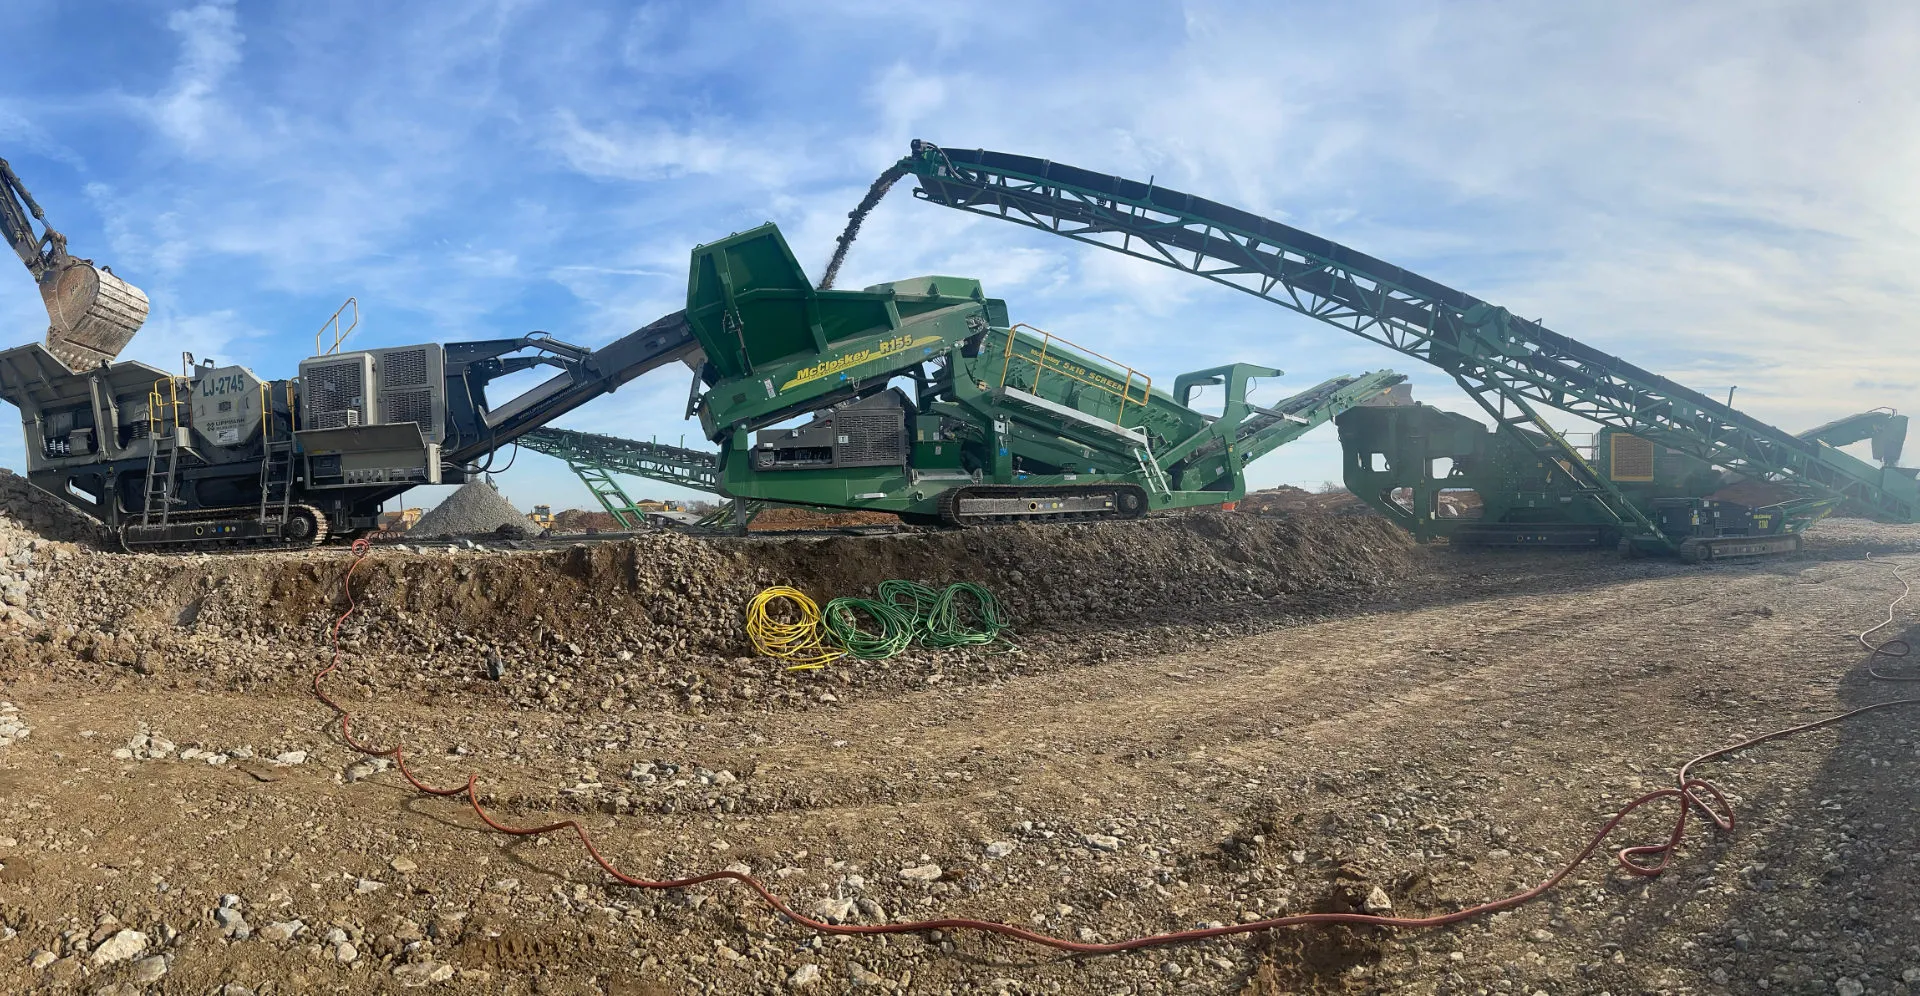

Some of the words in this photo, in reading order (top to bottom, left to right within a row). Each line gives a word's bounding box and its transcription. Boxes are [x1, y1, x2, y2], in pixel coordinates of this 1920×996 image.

[796, 349, 870, 380] McCloskey
[879, 334, 914, 354] R155
[1088, 371, 1125, 392] SCREEN
